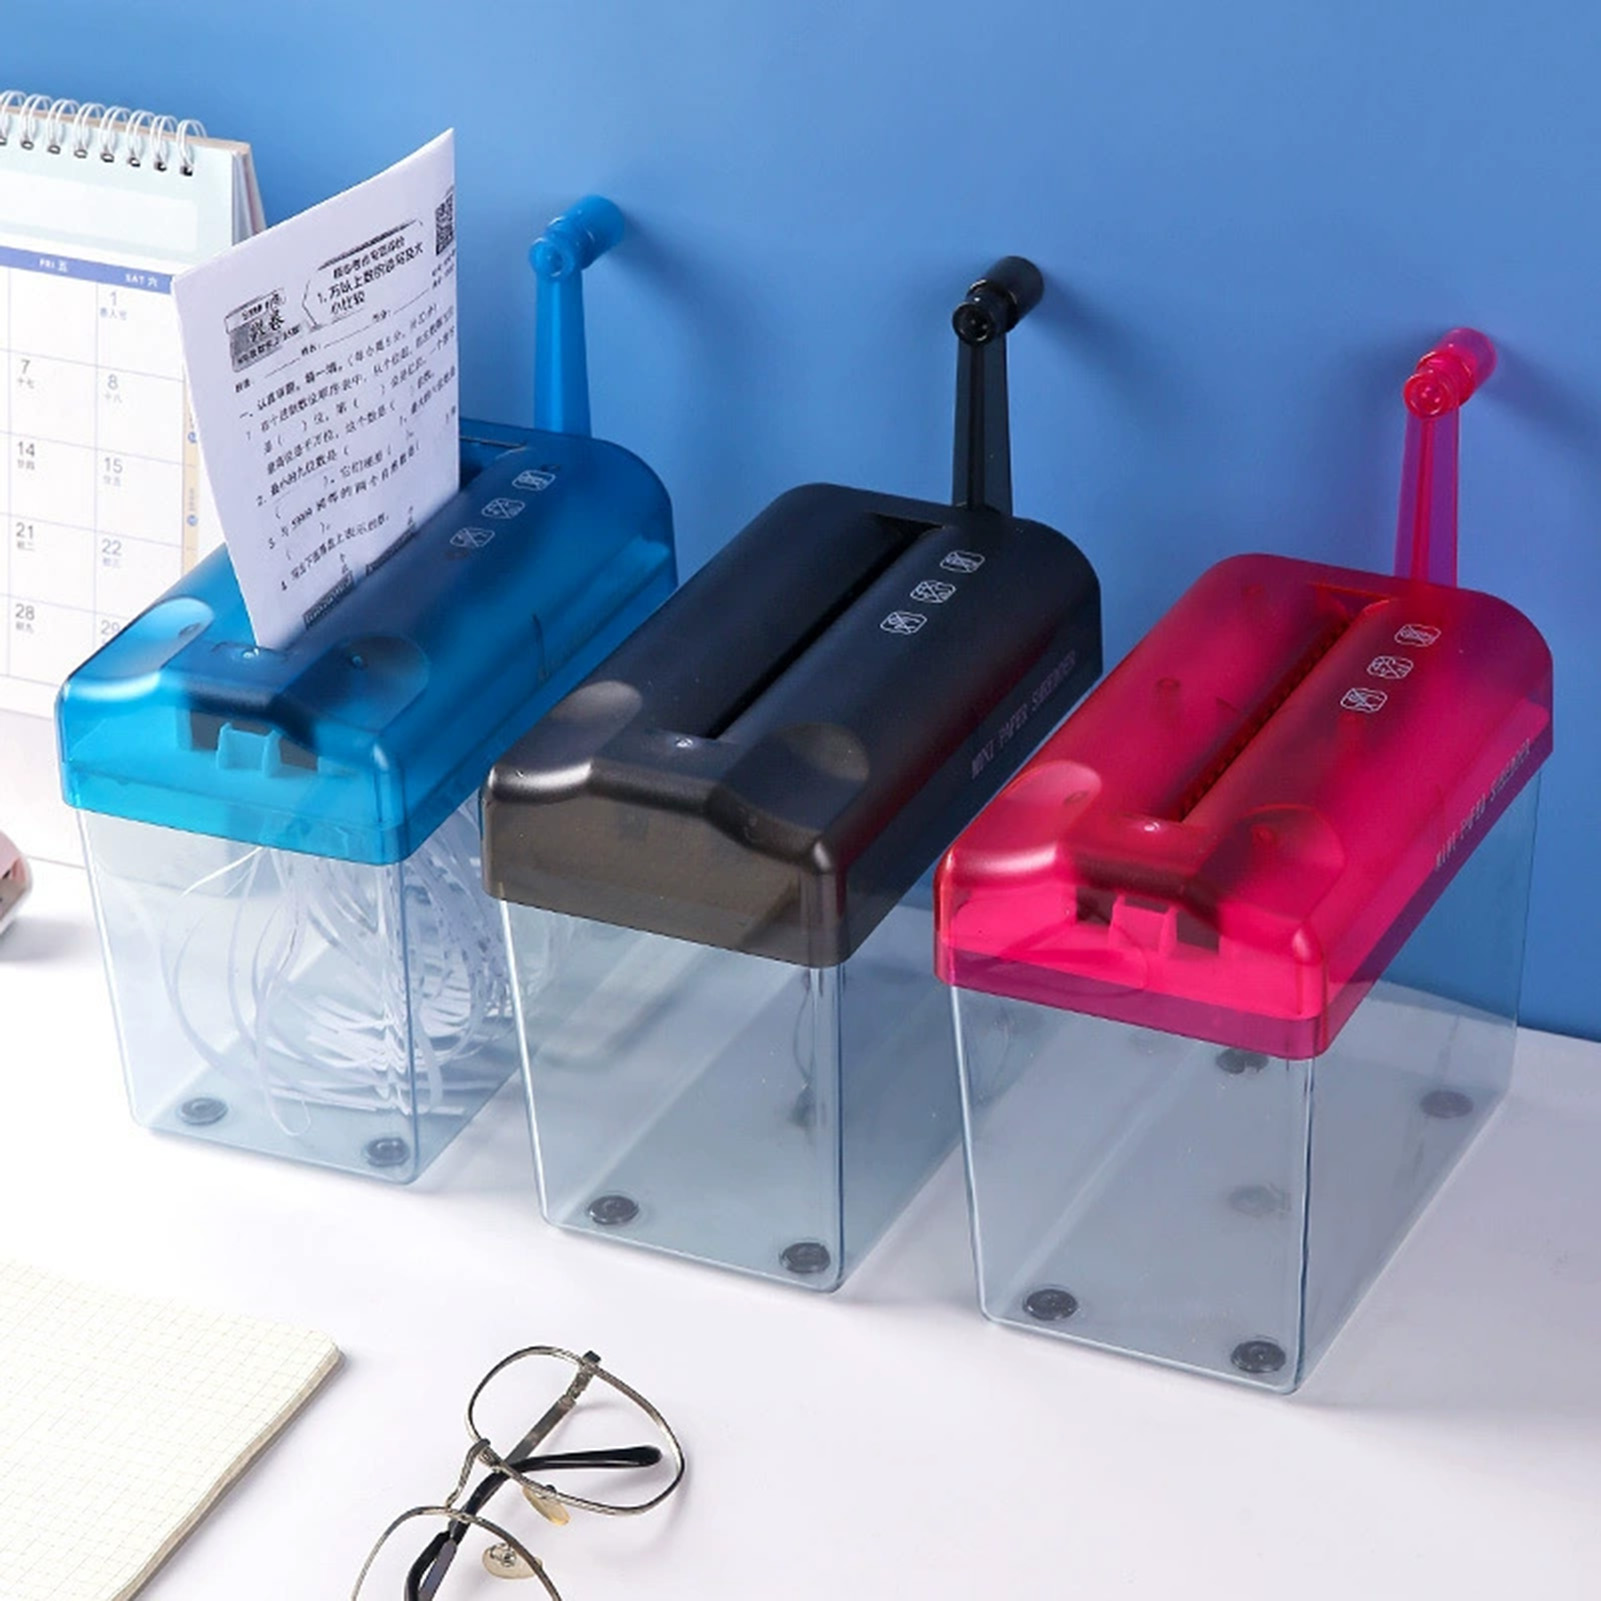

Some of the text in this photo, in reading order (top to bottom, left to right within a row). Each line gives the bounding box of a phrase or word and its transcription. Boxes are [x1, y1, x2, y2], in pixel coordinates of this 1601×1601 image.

[39, 258, 56, 270] FRI
[125, 273, 144, 285] SAT
[20, 358, 31, 374] 7
[107, 373, 119, 390] 8
[17, 440, 36, 457] 14
[104, 456, 124, 474] 15
[16, 521, 34, 539] 21
[101, 538, 122, 556] 22
[15, 603, 35, 621] 28
